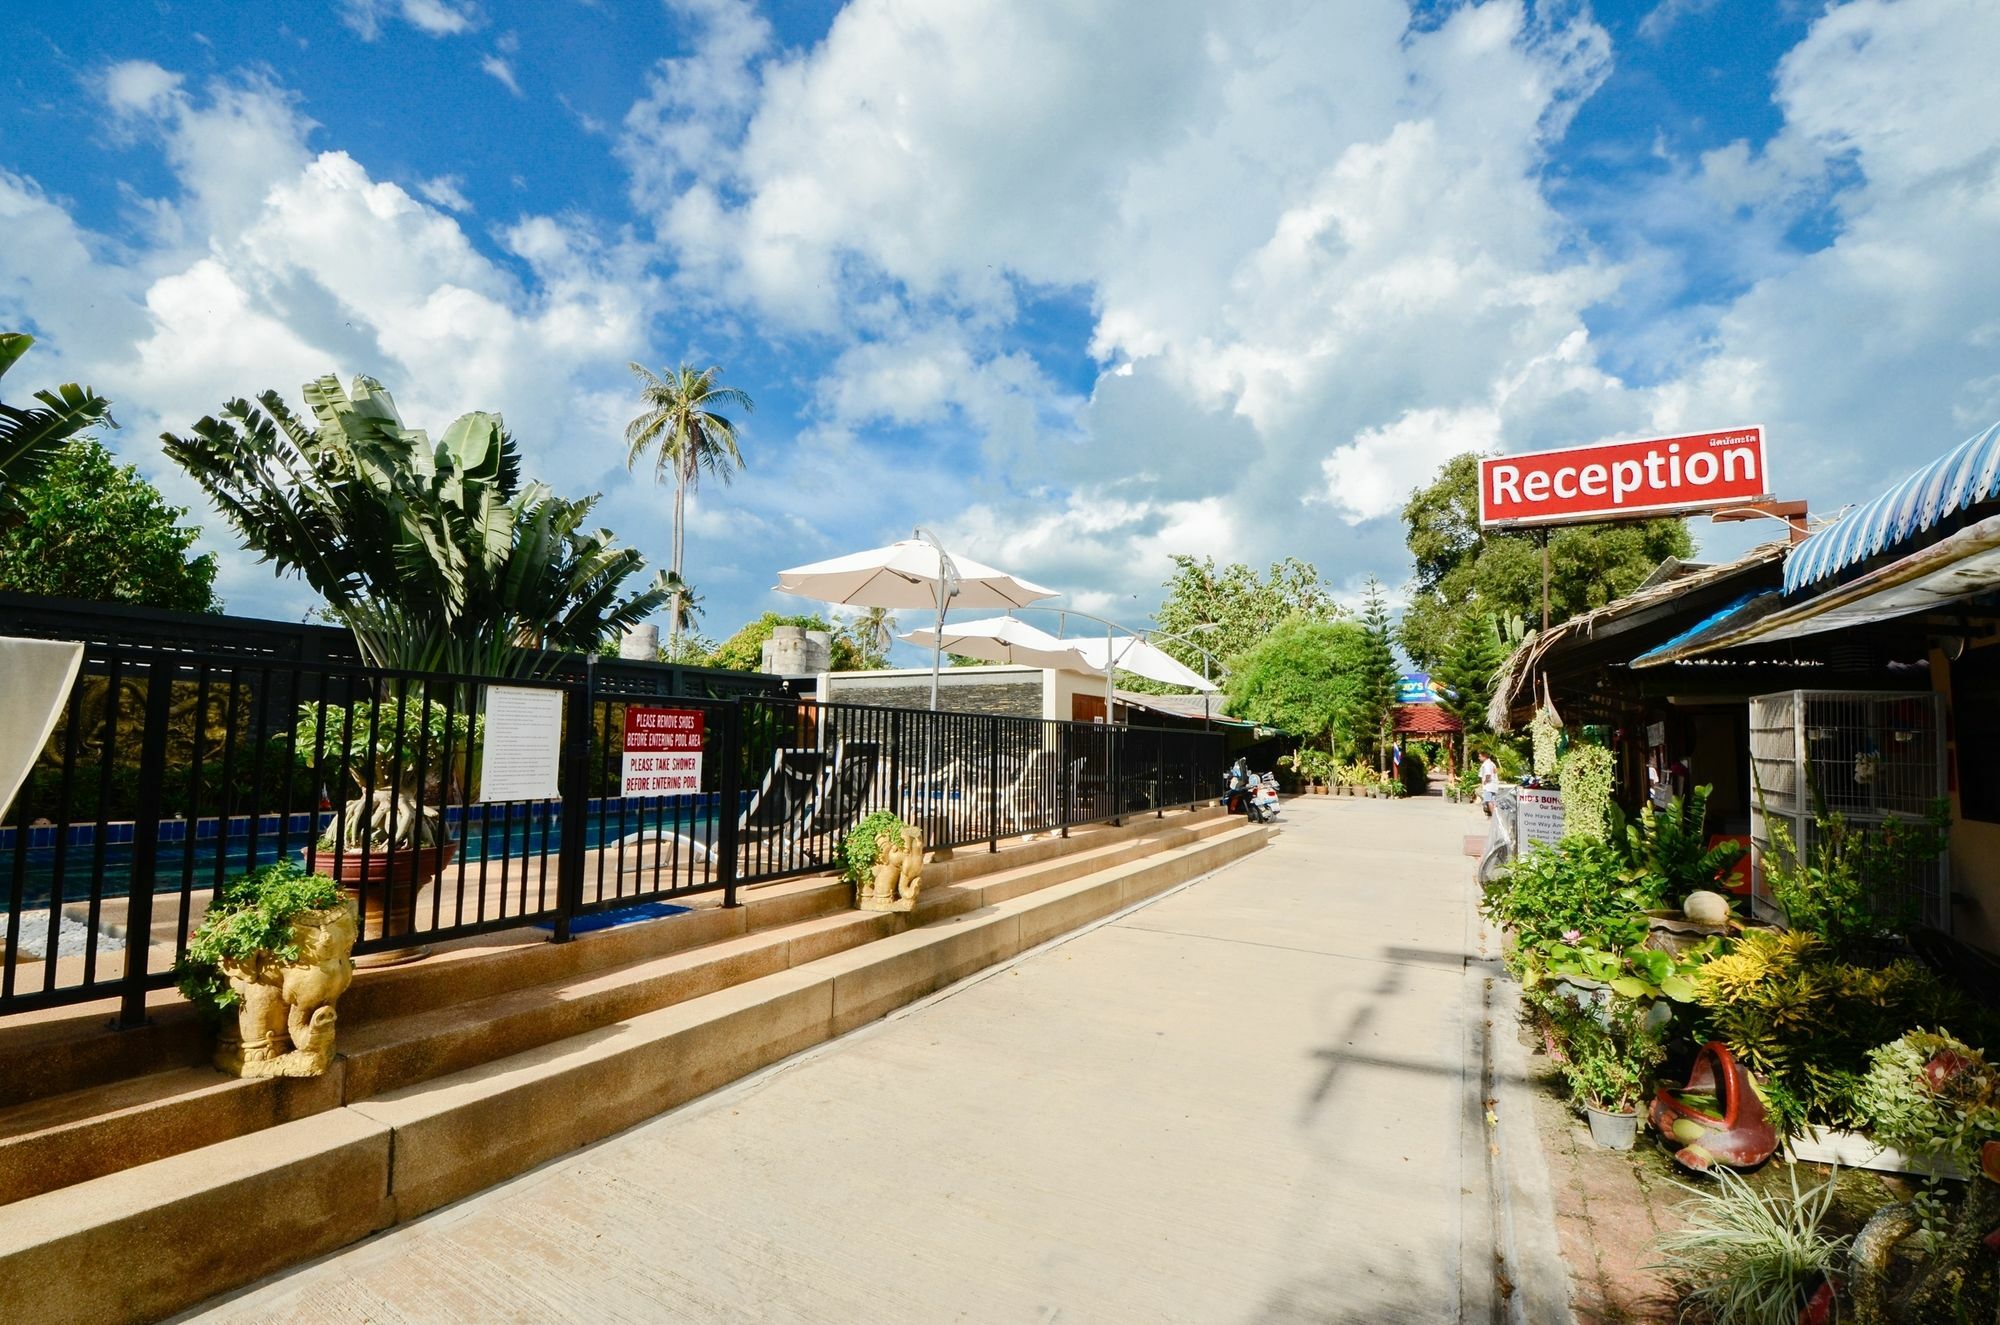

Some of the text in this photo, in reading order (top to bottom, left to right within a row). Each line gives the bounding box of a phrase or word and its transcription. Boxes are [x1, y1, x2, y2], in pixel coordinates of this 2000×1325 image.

[1492, 443, 1756, 505] Reception
[636, 713, 695, 729] PLEASE REMOVE SHOES
[627, 732, 701, 747] BEFORE ENTERING POOL AREA
[630, 757, 696, 772] PLEASE TAKE SHOWER
[626, 775, 697, 791] BEFORE ENTERING POOL
[1520, 795, 1539, 803] NID'S
